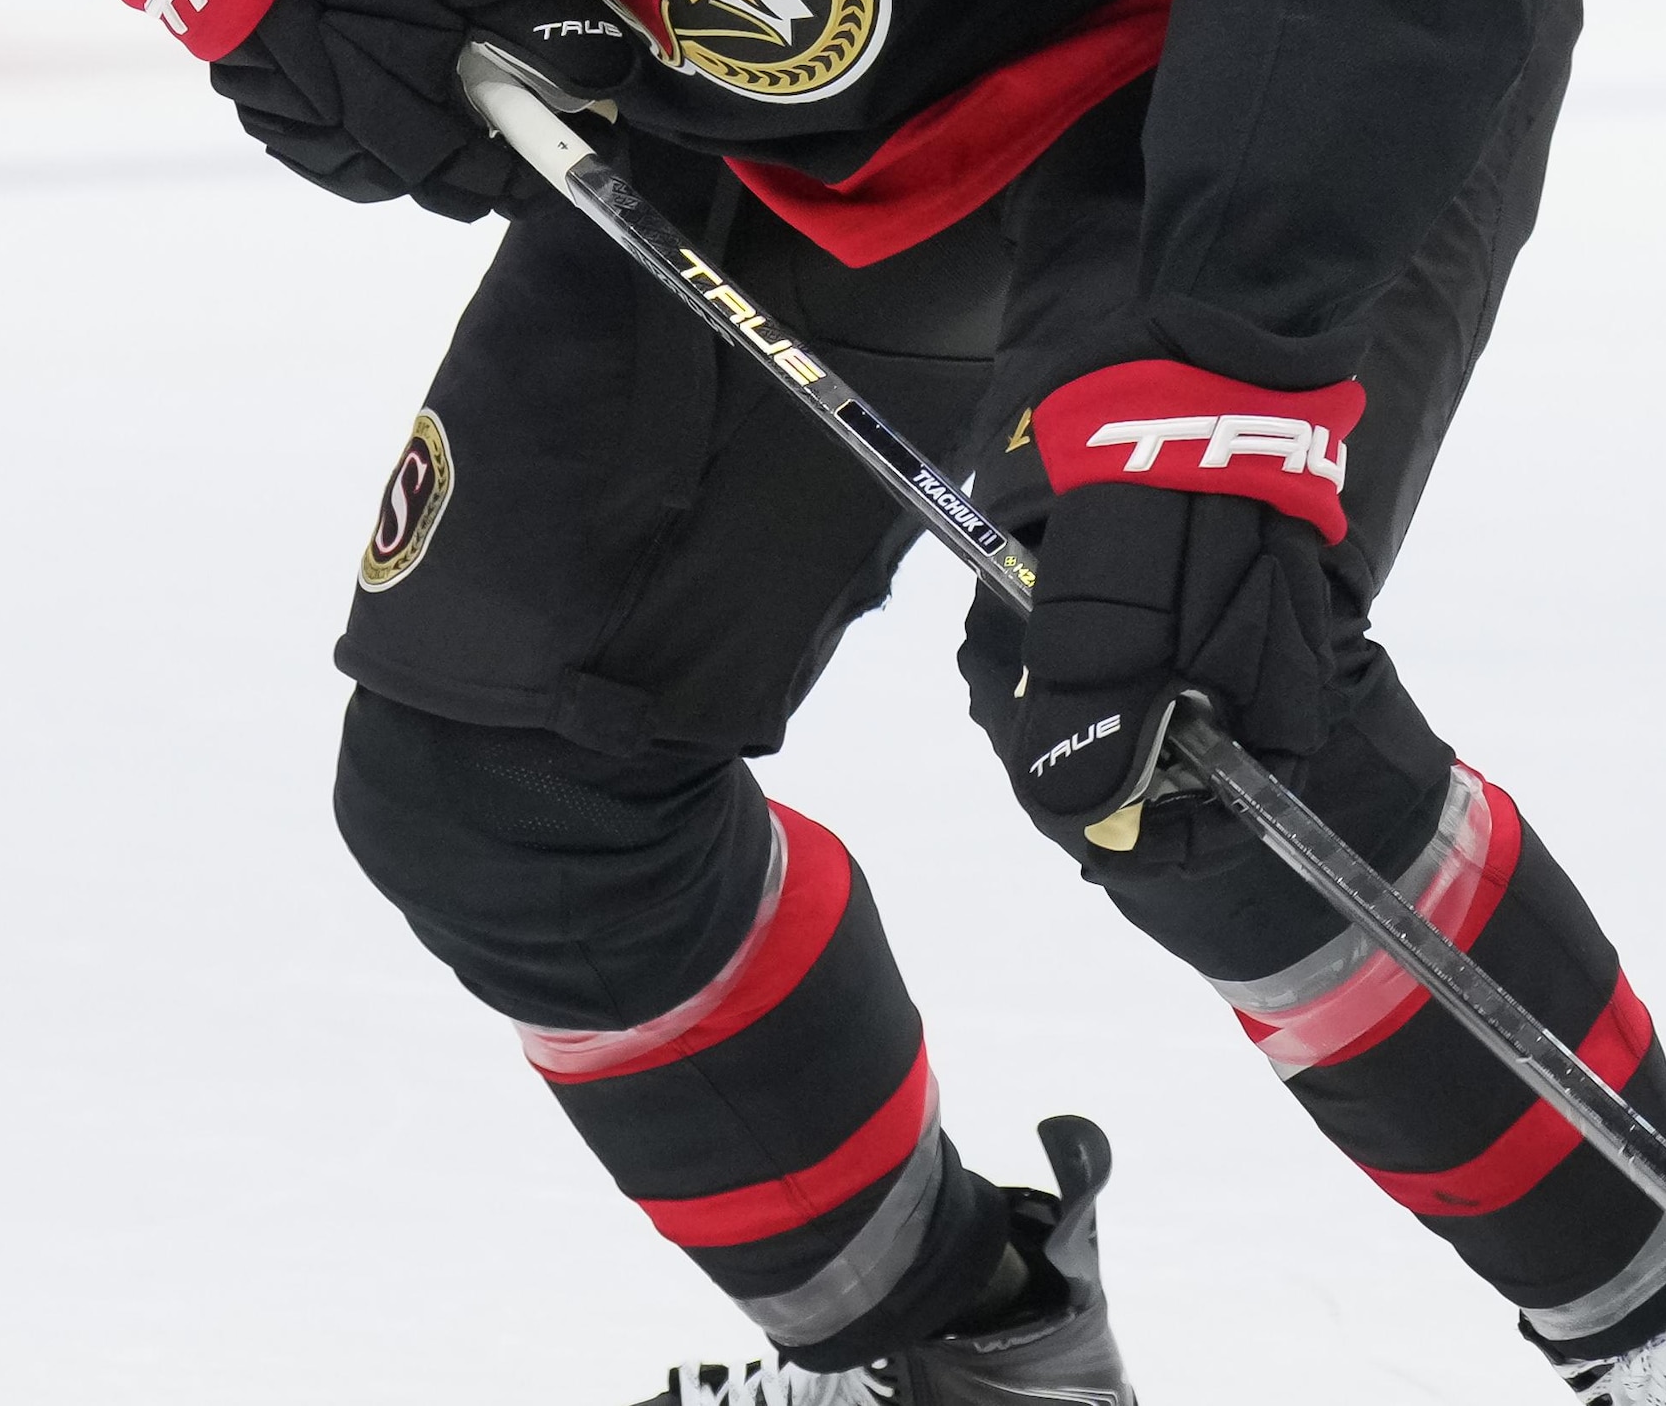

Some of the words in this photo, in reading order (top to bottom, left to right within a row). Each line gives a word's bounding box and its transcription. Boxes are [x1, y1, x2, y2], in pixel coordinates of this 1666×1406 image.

[532, 18, 624, 40] TRUE
[678, 247, 827, 386] TRUE
[1085, 414, 1348, 495] TRU
[374, 450, 429, 557] S
[912, 469, 984, 533] TKACHUK
[1029, 713, 1122, 780] TRUE
